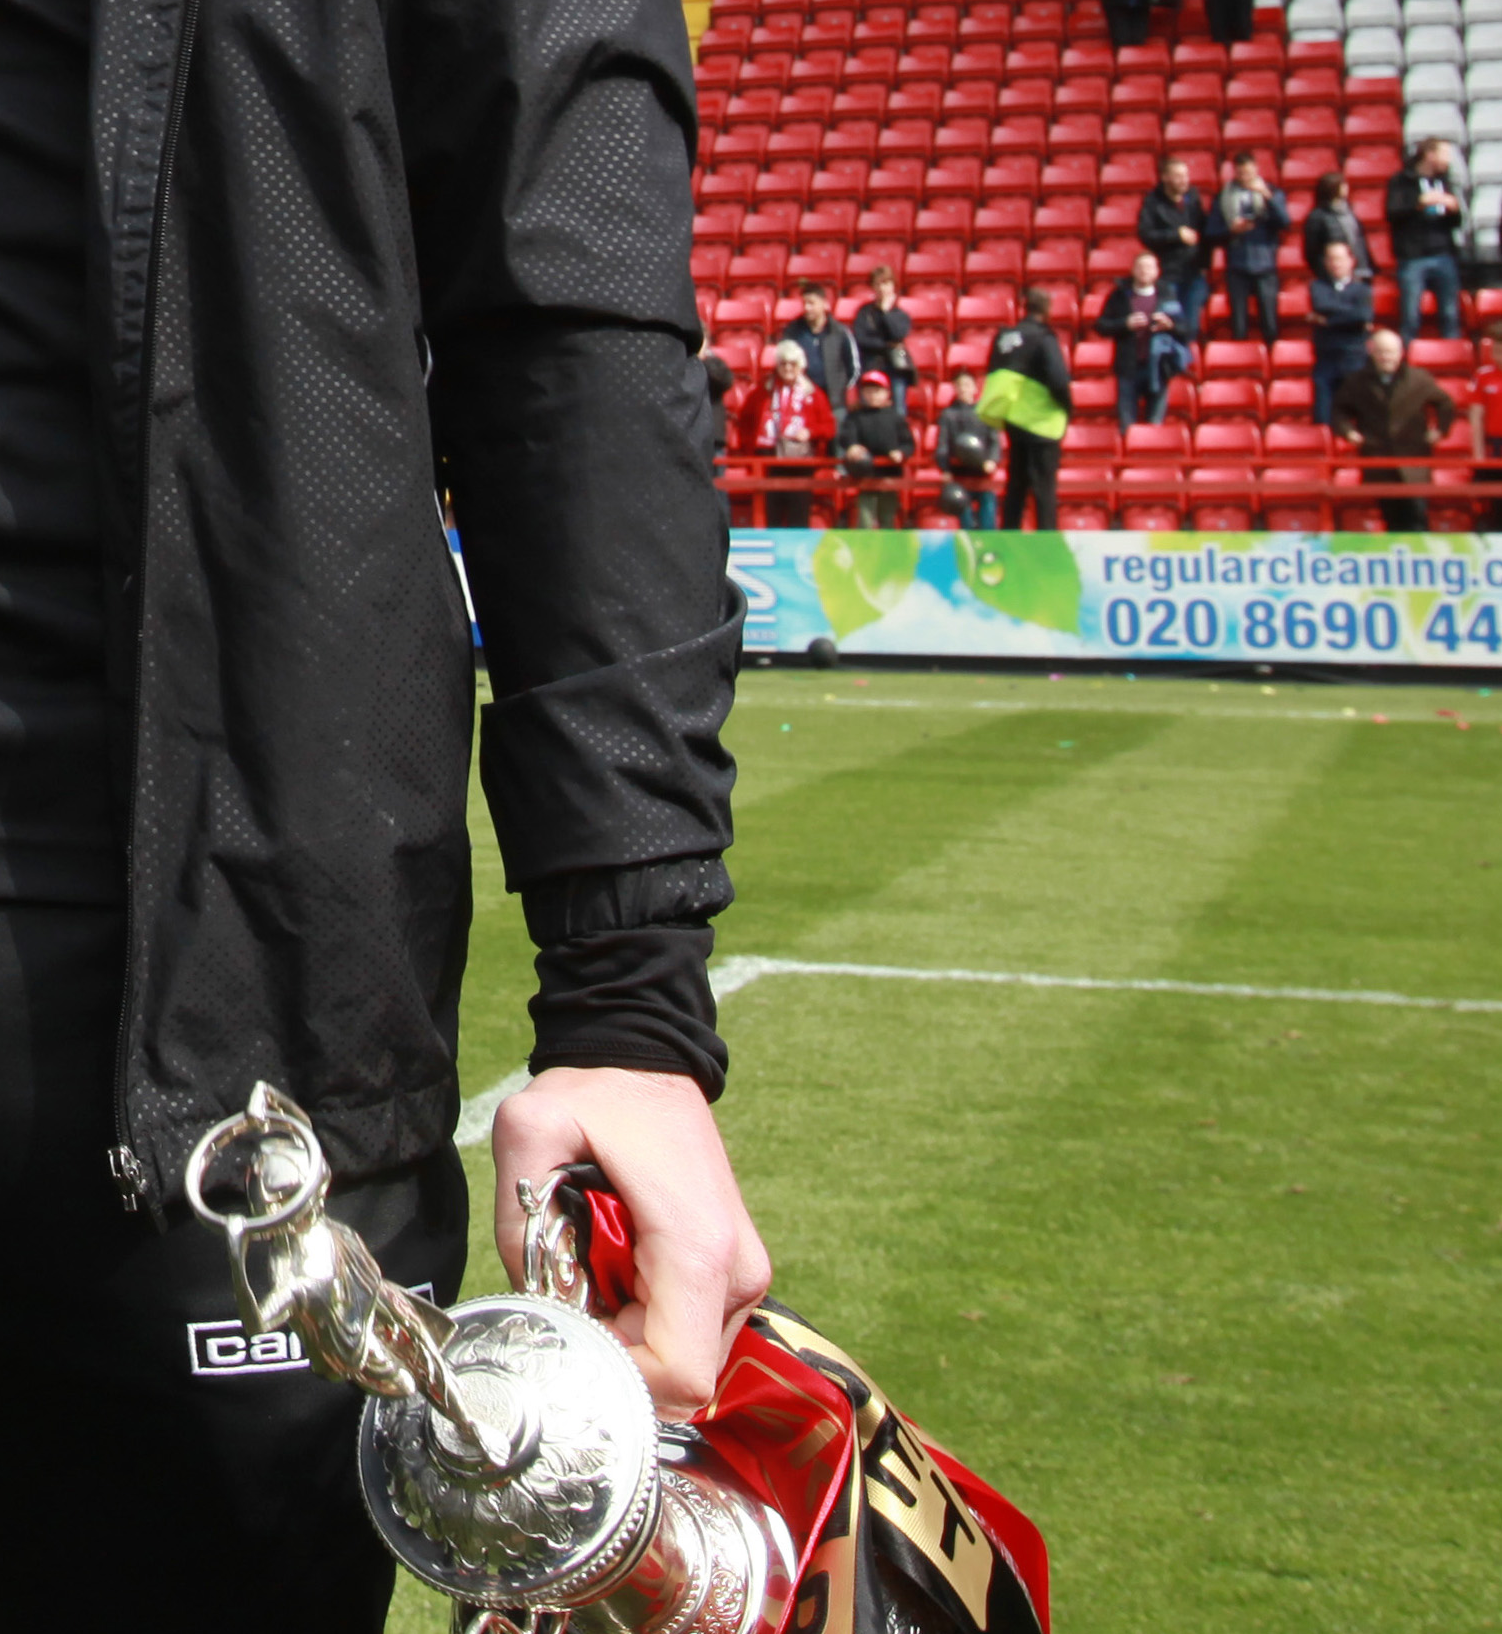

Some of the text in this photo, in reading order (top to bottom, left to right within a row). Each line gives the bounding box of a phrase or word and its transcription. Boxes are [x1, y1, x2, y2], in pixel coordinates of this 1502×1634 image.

[1105, 597, 1502, 654] 020 8690 44
